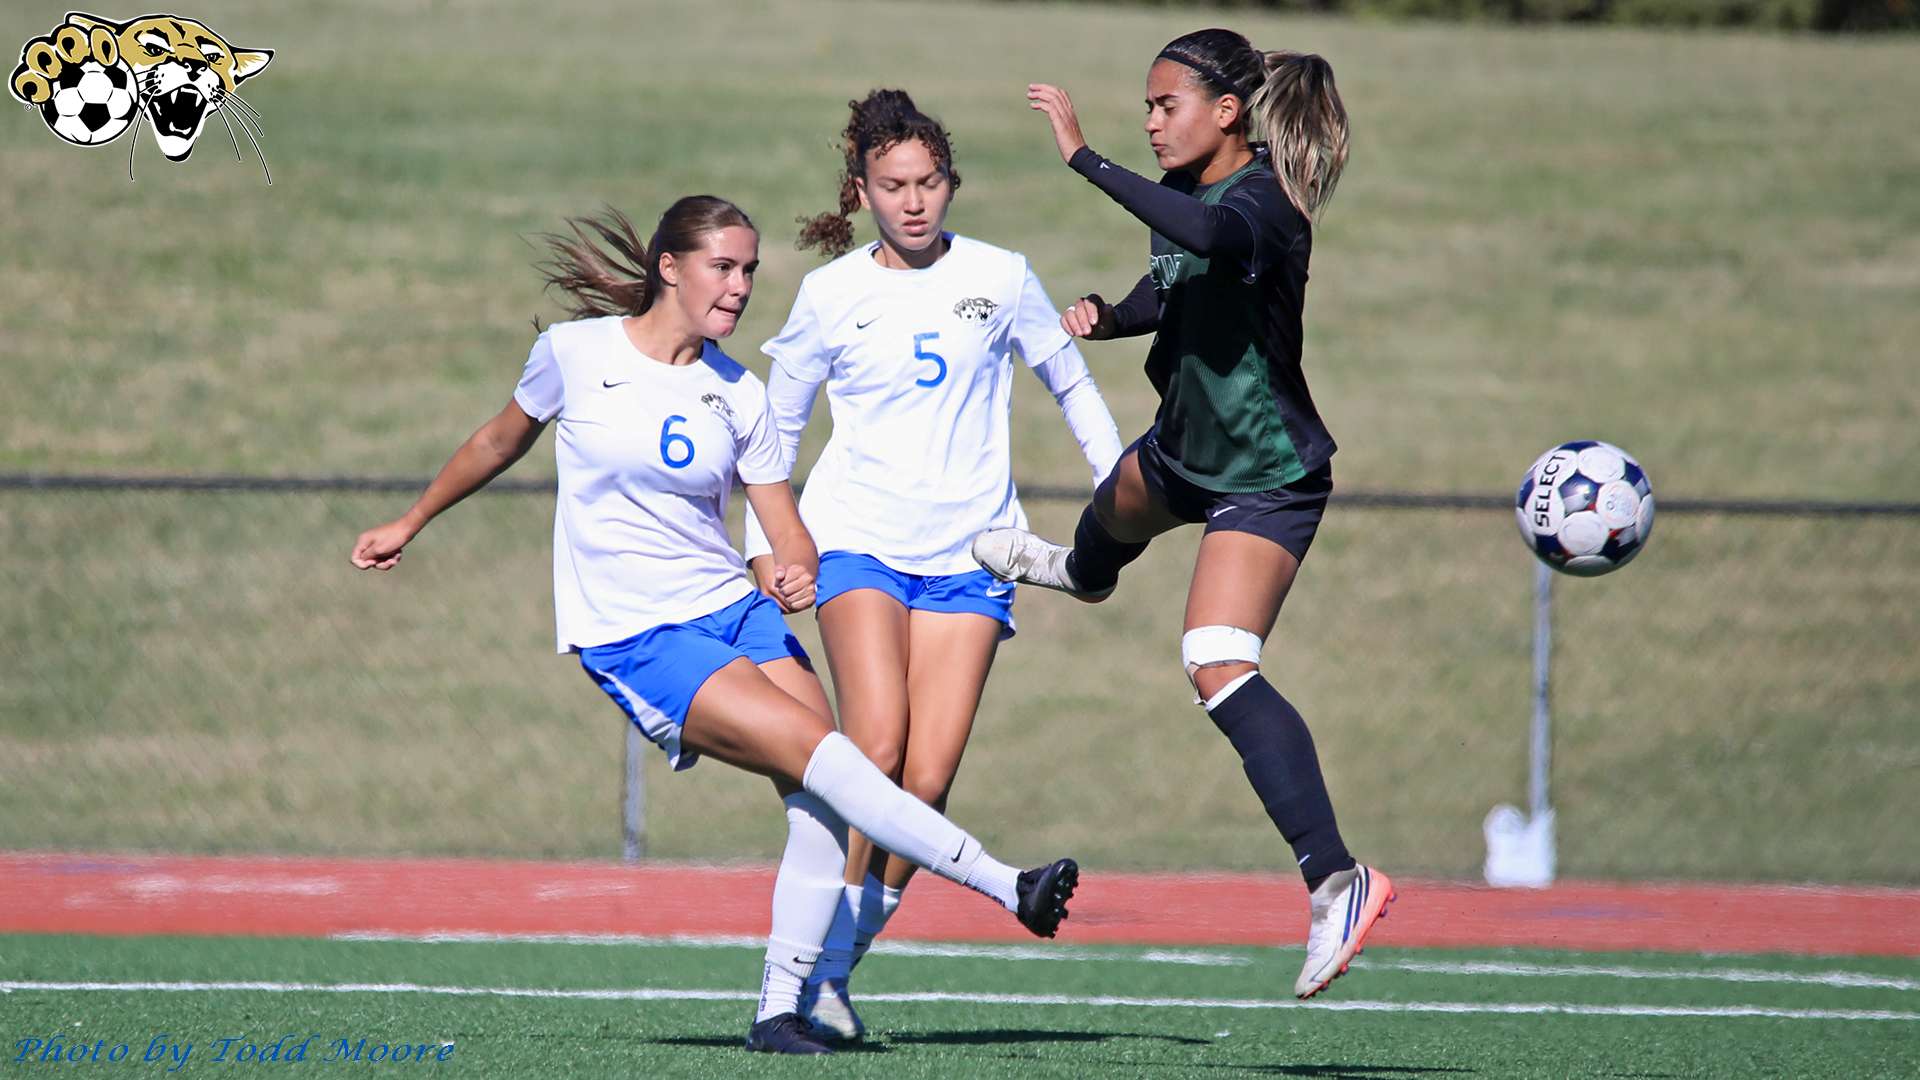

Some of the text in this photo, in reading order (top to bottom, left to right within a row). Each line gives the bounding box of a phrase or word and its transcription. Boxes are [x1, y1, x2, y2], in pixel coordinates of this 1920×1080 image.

[912, 331, 948, 388] 5
[659, 414, 695, 469] 6
[1533, 455, 1567, 528] SELECT
